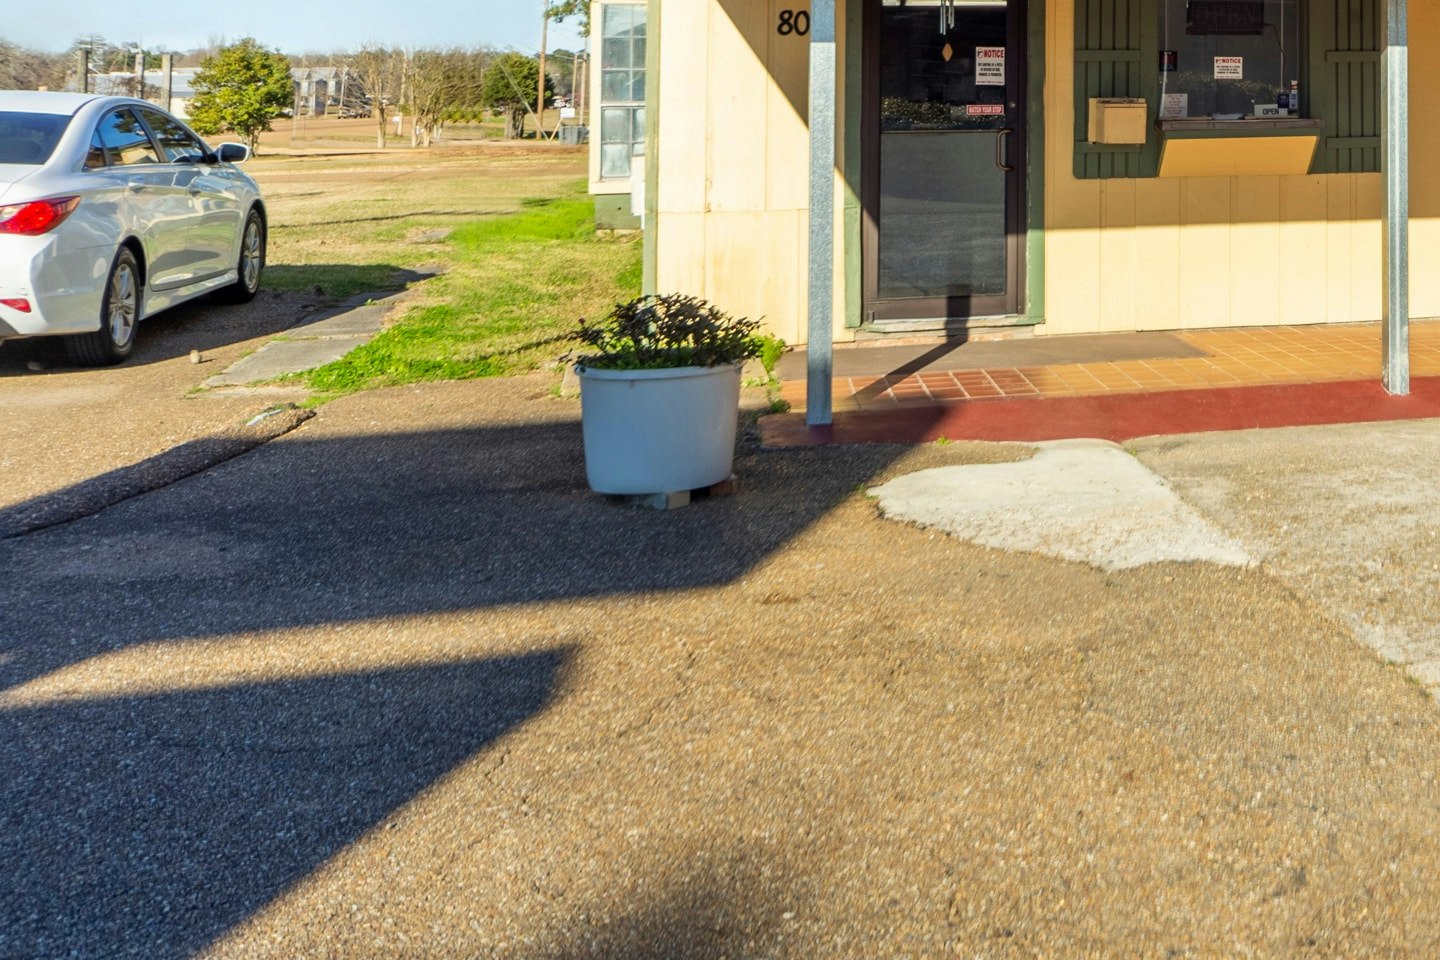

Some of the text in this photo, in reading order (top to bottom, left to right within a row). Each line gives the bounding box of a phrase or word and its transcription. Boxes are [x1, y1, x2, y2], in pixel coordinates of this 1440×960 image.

[777, 10, 811, 36] 80
[983, 49, 1004, 58] NOTICE
[1262, 107, 1279, 116] OPEN
